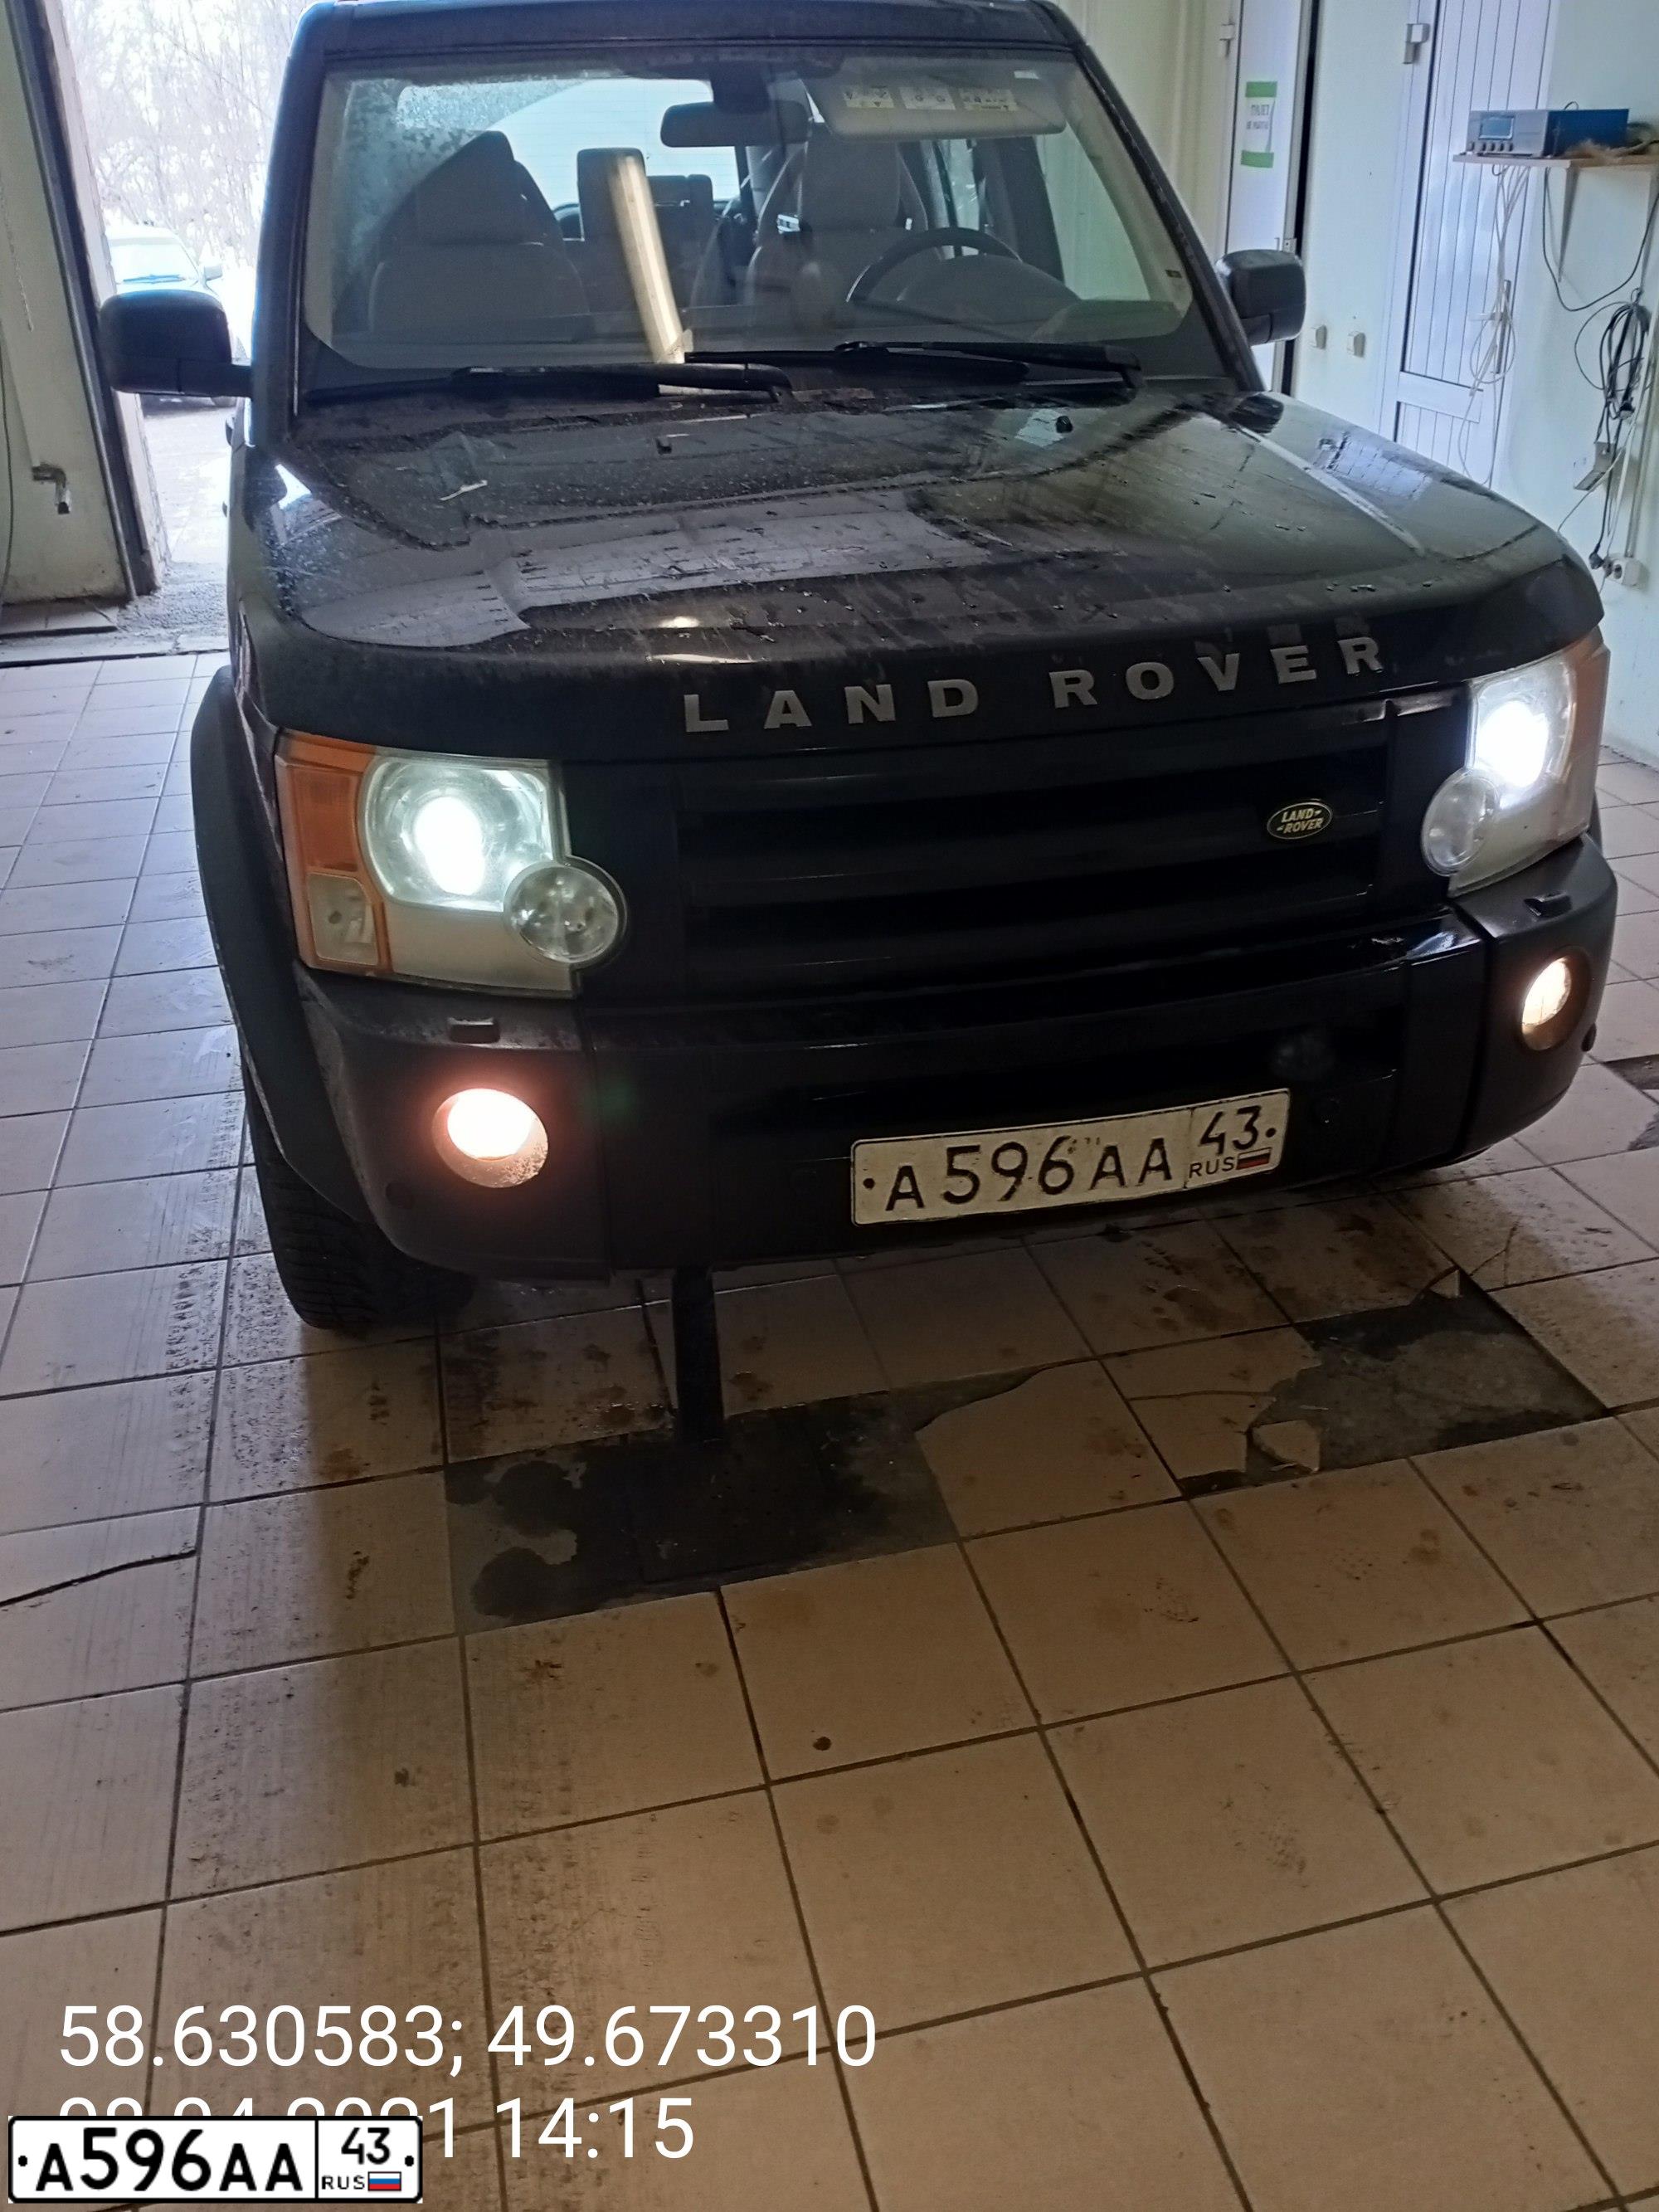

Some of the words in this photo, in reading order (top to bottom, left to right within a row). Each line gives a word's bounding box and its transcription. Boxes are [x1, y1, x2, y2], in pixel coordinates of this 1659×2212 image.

[684, 680, 979, 733] LAND
[1048, 636, 1384, 709] ROVER
[1281, 807, 1315, 823] LAND
[1282, 817, 1325, 834] ROVER
[1199, 1105, 1262, 1156] 43
[1189, 1157, 1234, 1179] RUS
